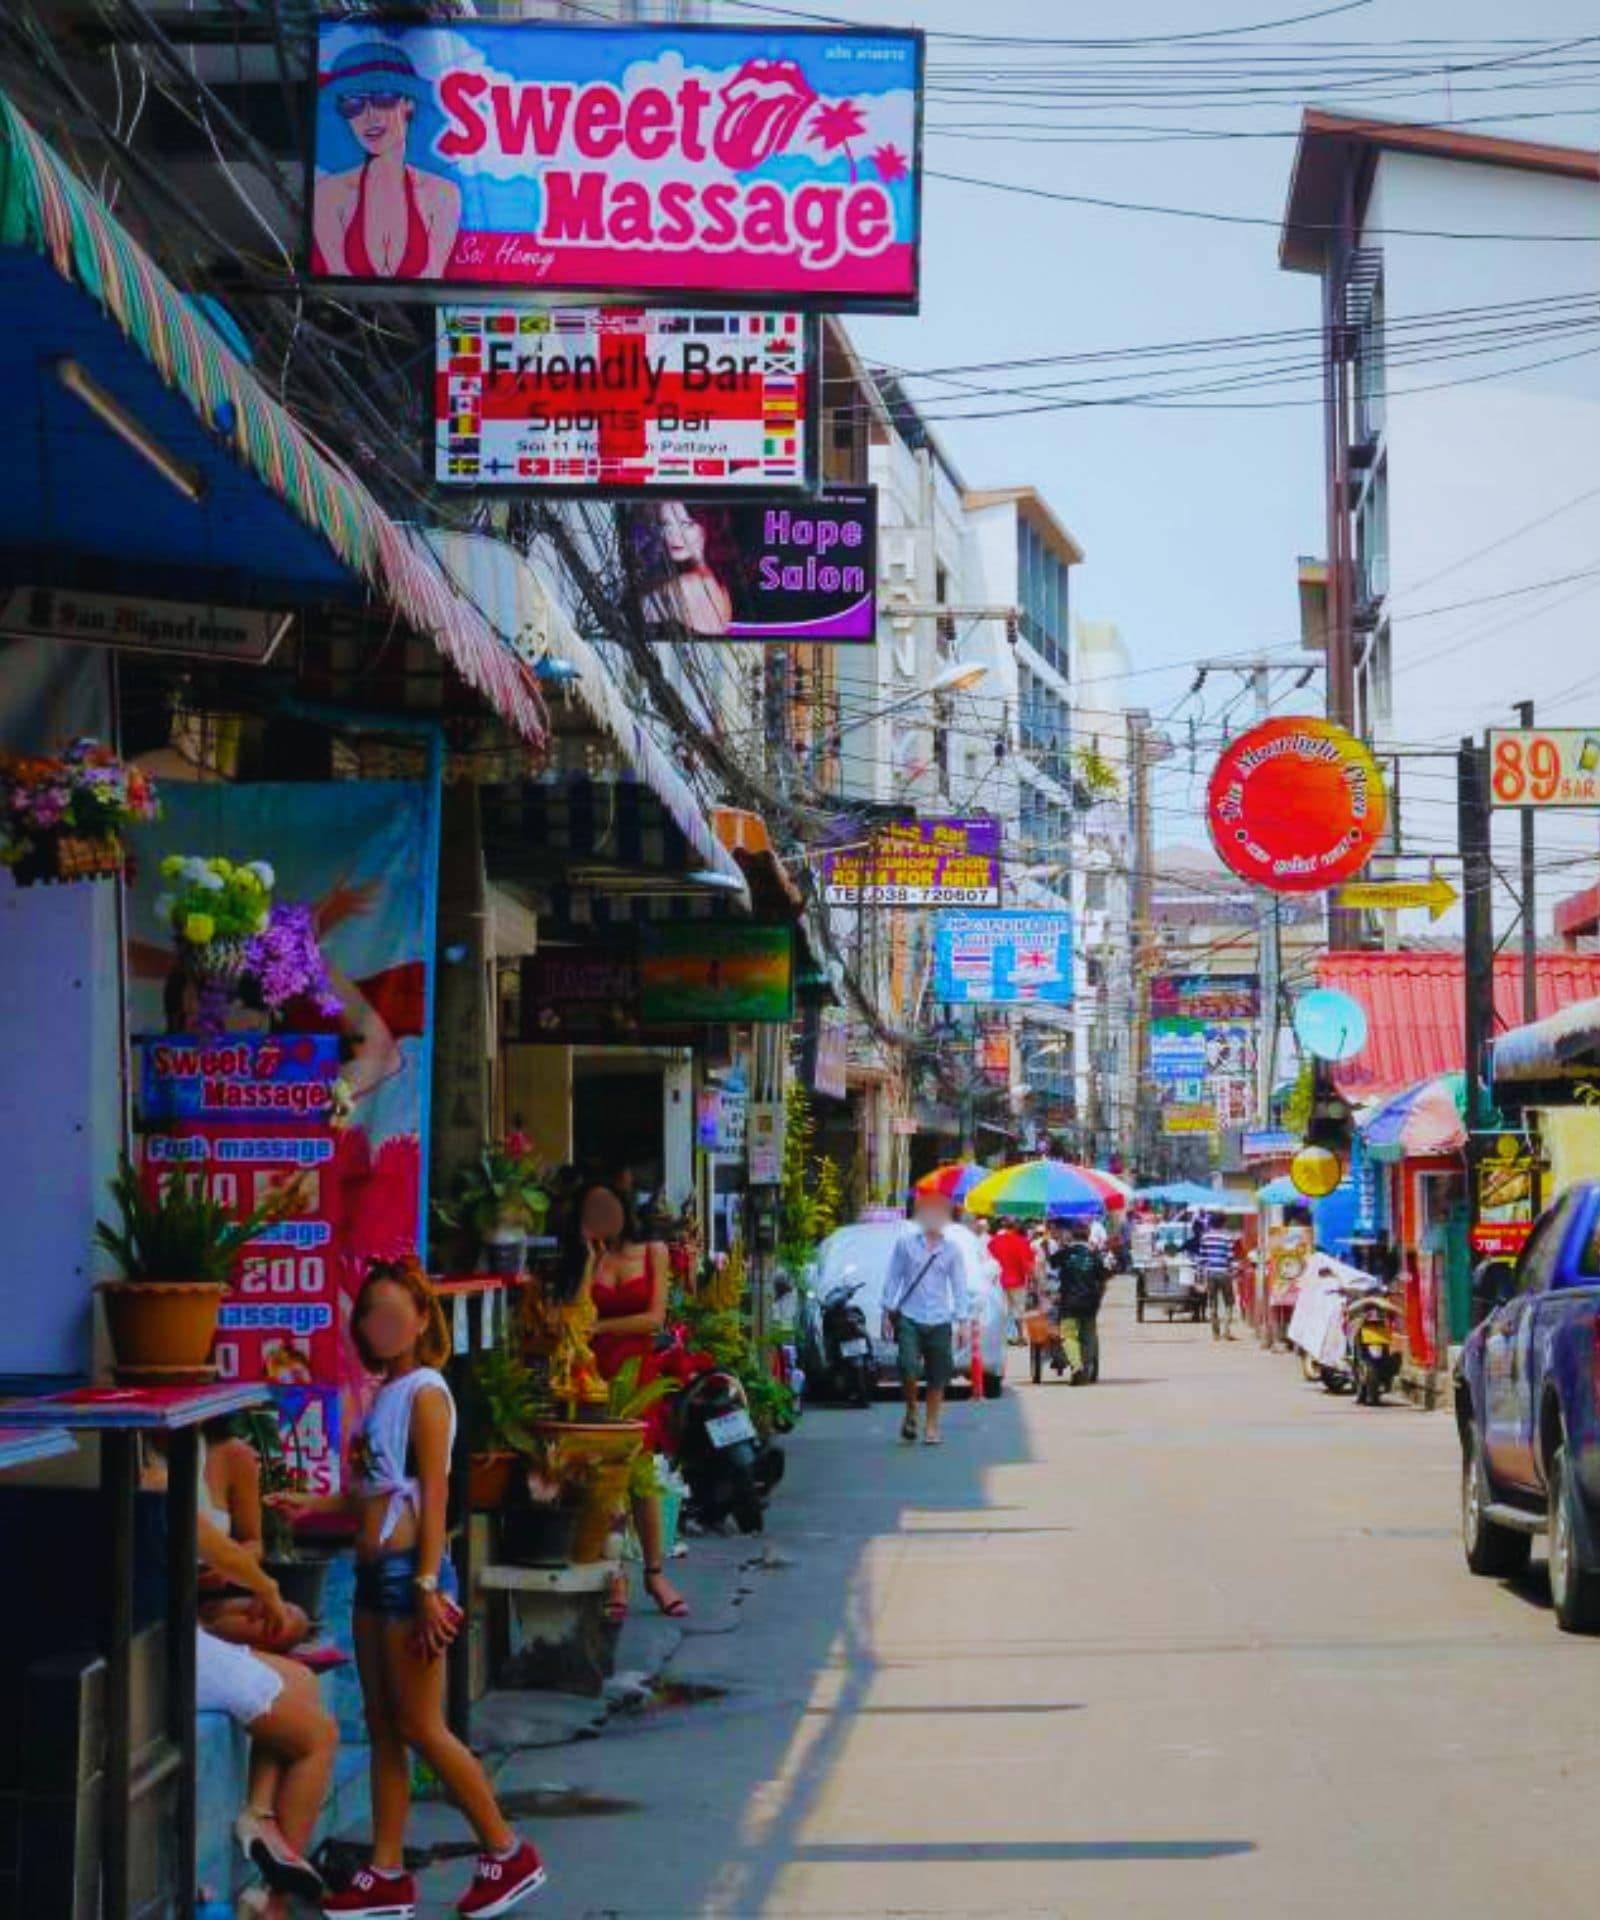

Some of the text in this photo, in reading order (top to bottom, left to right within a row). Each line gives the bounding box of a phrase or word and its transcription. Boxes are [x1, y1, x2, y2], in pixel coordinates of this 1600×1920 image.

[437, 71, 711, 162] Sweet
[542, 171, 891, 259] Massage
[455, 237, 488, 265] Soi
[487, 341, 758, 405] Friendly Bar
[527, 402, 716, 435] Sports Bar
[516, 439, 546, 452] Soi
[759, 555, 865, 593] Salon
[1491, 738, 1561, 802] 89
[155, 1045, 250, 1076] Sweet
[203, 1080, 330, 1114] Massage
[214, 1138, 334, 1166] massage
[241, 1256, 325, 1293] 200
[218, 1303, 333, 1336] assage
